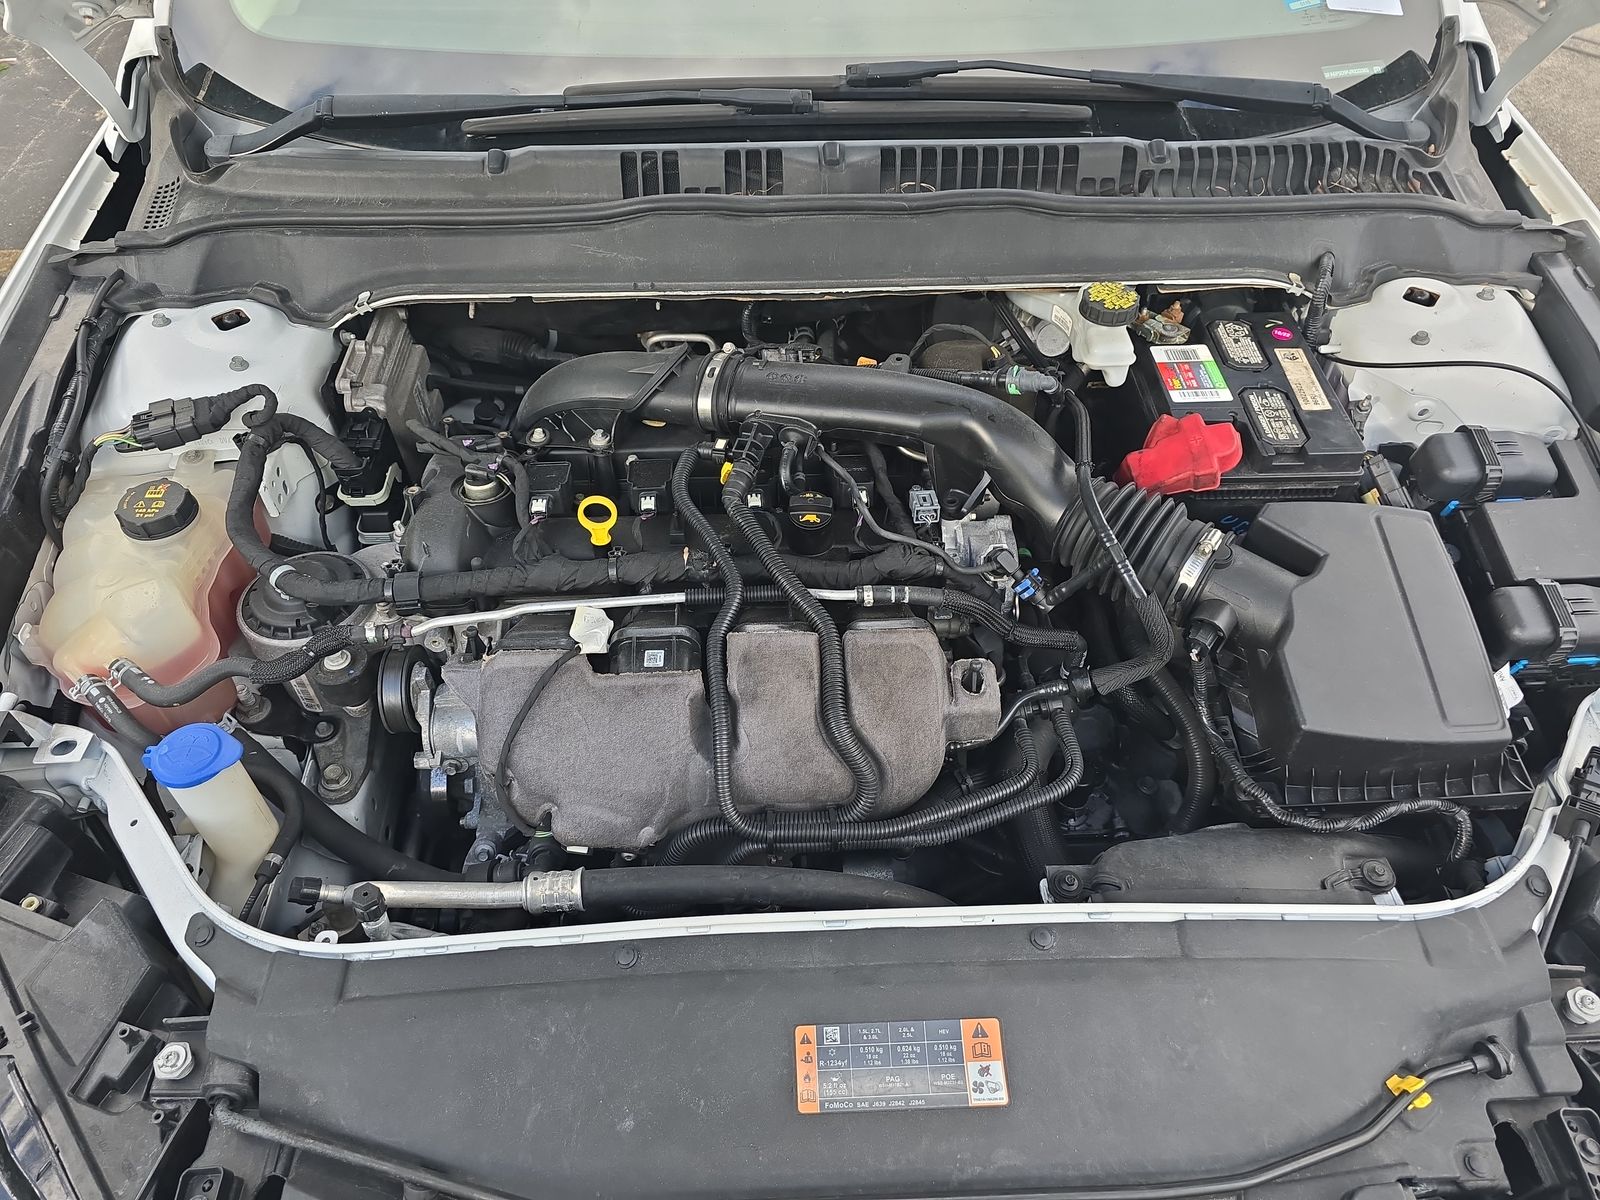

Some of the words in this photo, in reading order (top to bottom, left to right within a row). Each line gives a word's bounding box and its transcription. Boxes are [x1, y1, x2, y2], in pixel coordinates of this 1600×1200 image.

[860, 1046, 875, 1054] 0.510
[875, 1046, 884, 1054] kg
[913, 1045, 921, 1053] kg
[949, 1044, 957, 1052] kg
[819, 1059, 848, 1067] R-1234yf
[824, 1101, 854, 1109] FoMoCo
